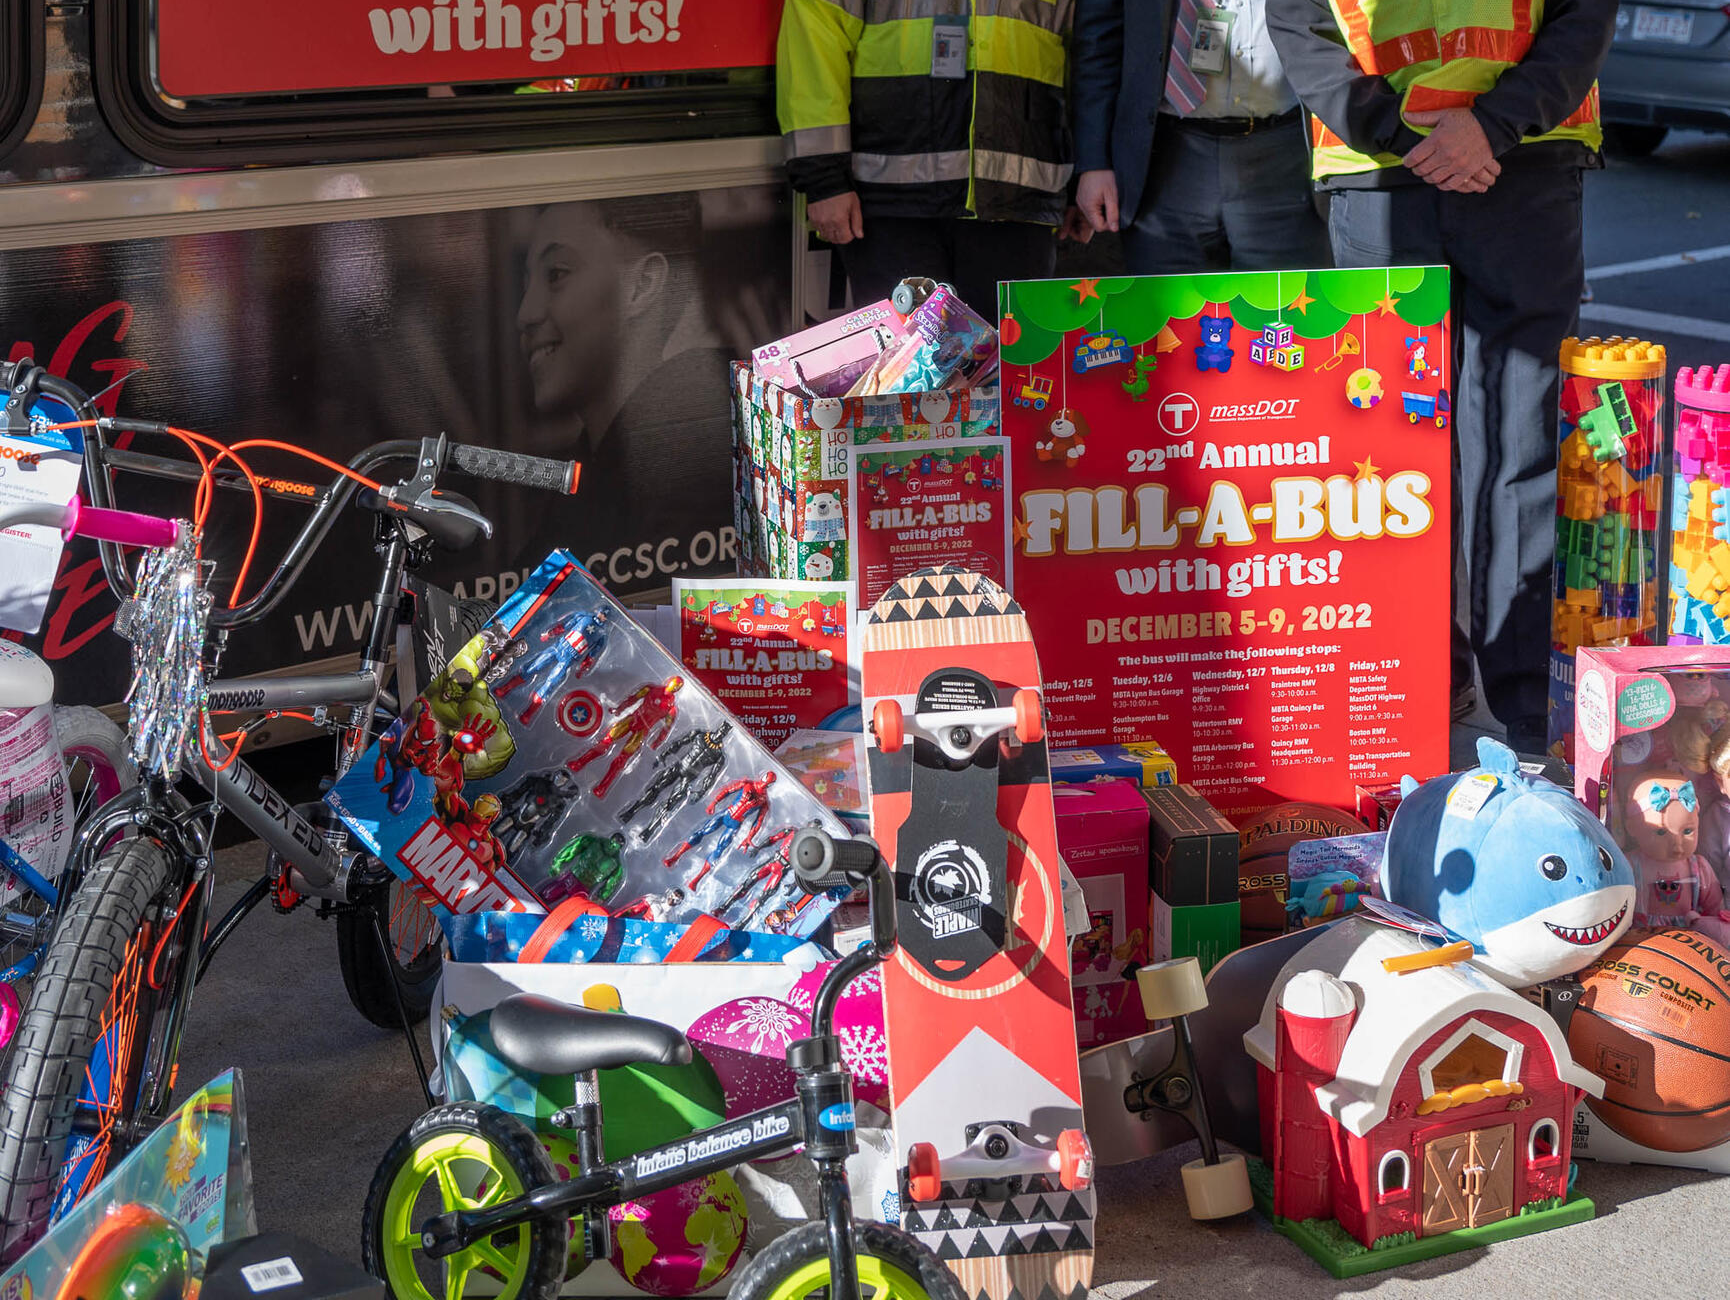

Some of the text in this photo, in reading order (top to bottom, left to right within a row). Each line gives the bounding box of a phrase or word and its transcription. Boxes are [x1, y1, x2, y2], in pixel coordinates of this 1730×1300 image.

[758, 345, 782, 361] 48
[1209, 399, 1300, 418] massDOT
[935, 425, 956, 439] HO
[827, 431, 848, 446] HO
[827, 447, 848, 462] HO
[1126, 437, 1331, 473] 22nd Annual
[827, 462, 848, 476] HO
[900, 492, 961, 505] 22nd Annual
[869, 501, 992, 530] FILL-A-BUS
[1021, 470, 1434, 556] FILL-A-BUS
[897, 525, 965, 541] with gifts!
[890, 540, 973, 553] DECEMBER 5-9, 2022
[1115, 549, 1344, 598] with gifts!
[1086, 603, 1372, 645] DECEMBER 5-9, 2022
[730, 637, 798, 649] 22nd Annual
[695, 648, 834, 672] FILL-A-BUS
[1118, 644, 1341, 667] The bus will make the following stops:
[1271, 663, 1336, 676] Thursday, 12/8
[1349, 659, 1401, 672] Friday, 12/9
[1192, 667, 1266, 681] Wednesday, 12/7
[1349, 675, 1388, 684] MBTA Safety
[726, 673, 803, 688] with gifts!
[1072, 678, 1093, 688] 12/5
[1112, 673, 1173, 688] Tuesday, 12/6
[1271, 679, 1316, 689] Braintree RMV
[718, 688, 812, 698] DECEMBER 5-9, 2022
[1112, 688, 1184, 699] MBTA Lynn Bus Garage
[1192, 684, 1220, 695] Highway
[1221, 683, 1244, 692] District
[1271, 689, 1305, 698] 9:30-10:00
[1349, 685, 1387, 694] Department
[208, 688, 266, 710] mongoose
[1051, 693, 1097, 703] Everett Repair
[1192, 695, 1211, 704] Office
[1349, 693, 1406, 703] MassDOT Highway
[1271, 705, 1289, 713] MBTA
[1289, 704, 1312, 713] Quincy
[1349, 704, 1372, 712] District
[772, 714, 797, 724] 12/9
[1112, 713, 1169, 724] Southampton Bus
[1192, 717, 1243, 728] Watertown RMV
[1271, 715, 1294, 723] Garage
[1065, 728, 1107, 737] Maintenance
[1112, 726, 1135, 734] Garage
[1271, 724, 1308, 732] 10:30-11:00
[1349, 729, 1371, 737] Boston
[1271, 738, 1309, 748] Quincy RMV
[1349, 737, 1386, 746] 10:00-10:30
[1192, 745, 1211, 753] MBTA
[1271, 748, 1313, 757] Headquarters
[1192, 754, 1215, 763] Garage
[1349, 750, 1411, 761] State Transportation
[1271, 758, 1289, 766] 11:30
[1349, 762, 1376, 771] Building
[1211, 777, 1230, 785] Cabot
[1230, 776, 1242, 784] Bus
[1243, 775, 1266, 784] Garage
[327, 794, 342, 812] AGE
[1331, 843, 1361, 852] Mermaids
[402, 824, 514, 914] MARVE
[1239, 874, 1286, 890] ROSS
[933, 897, 979, 916] SKATEBOARDS
[934, 907, 979, 937] MAPLE
[1594, 959, 1716, 1012] ROSS COURT
[1659, 991, 1695, 1012] COMPOSITE
[687, 1126, 752, 1164] balance
[754, 1113, 791, 1142] bike
